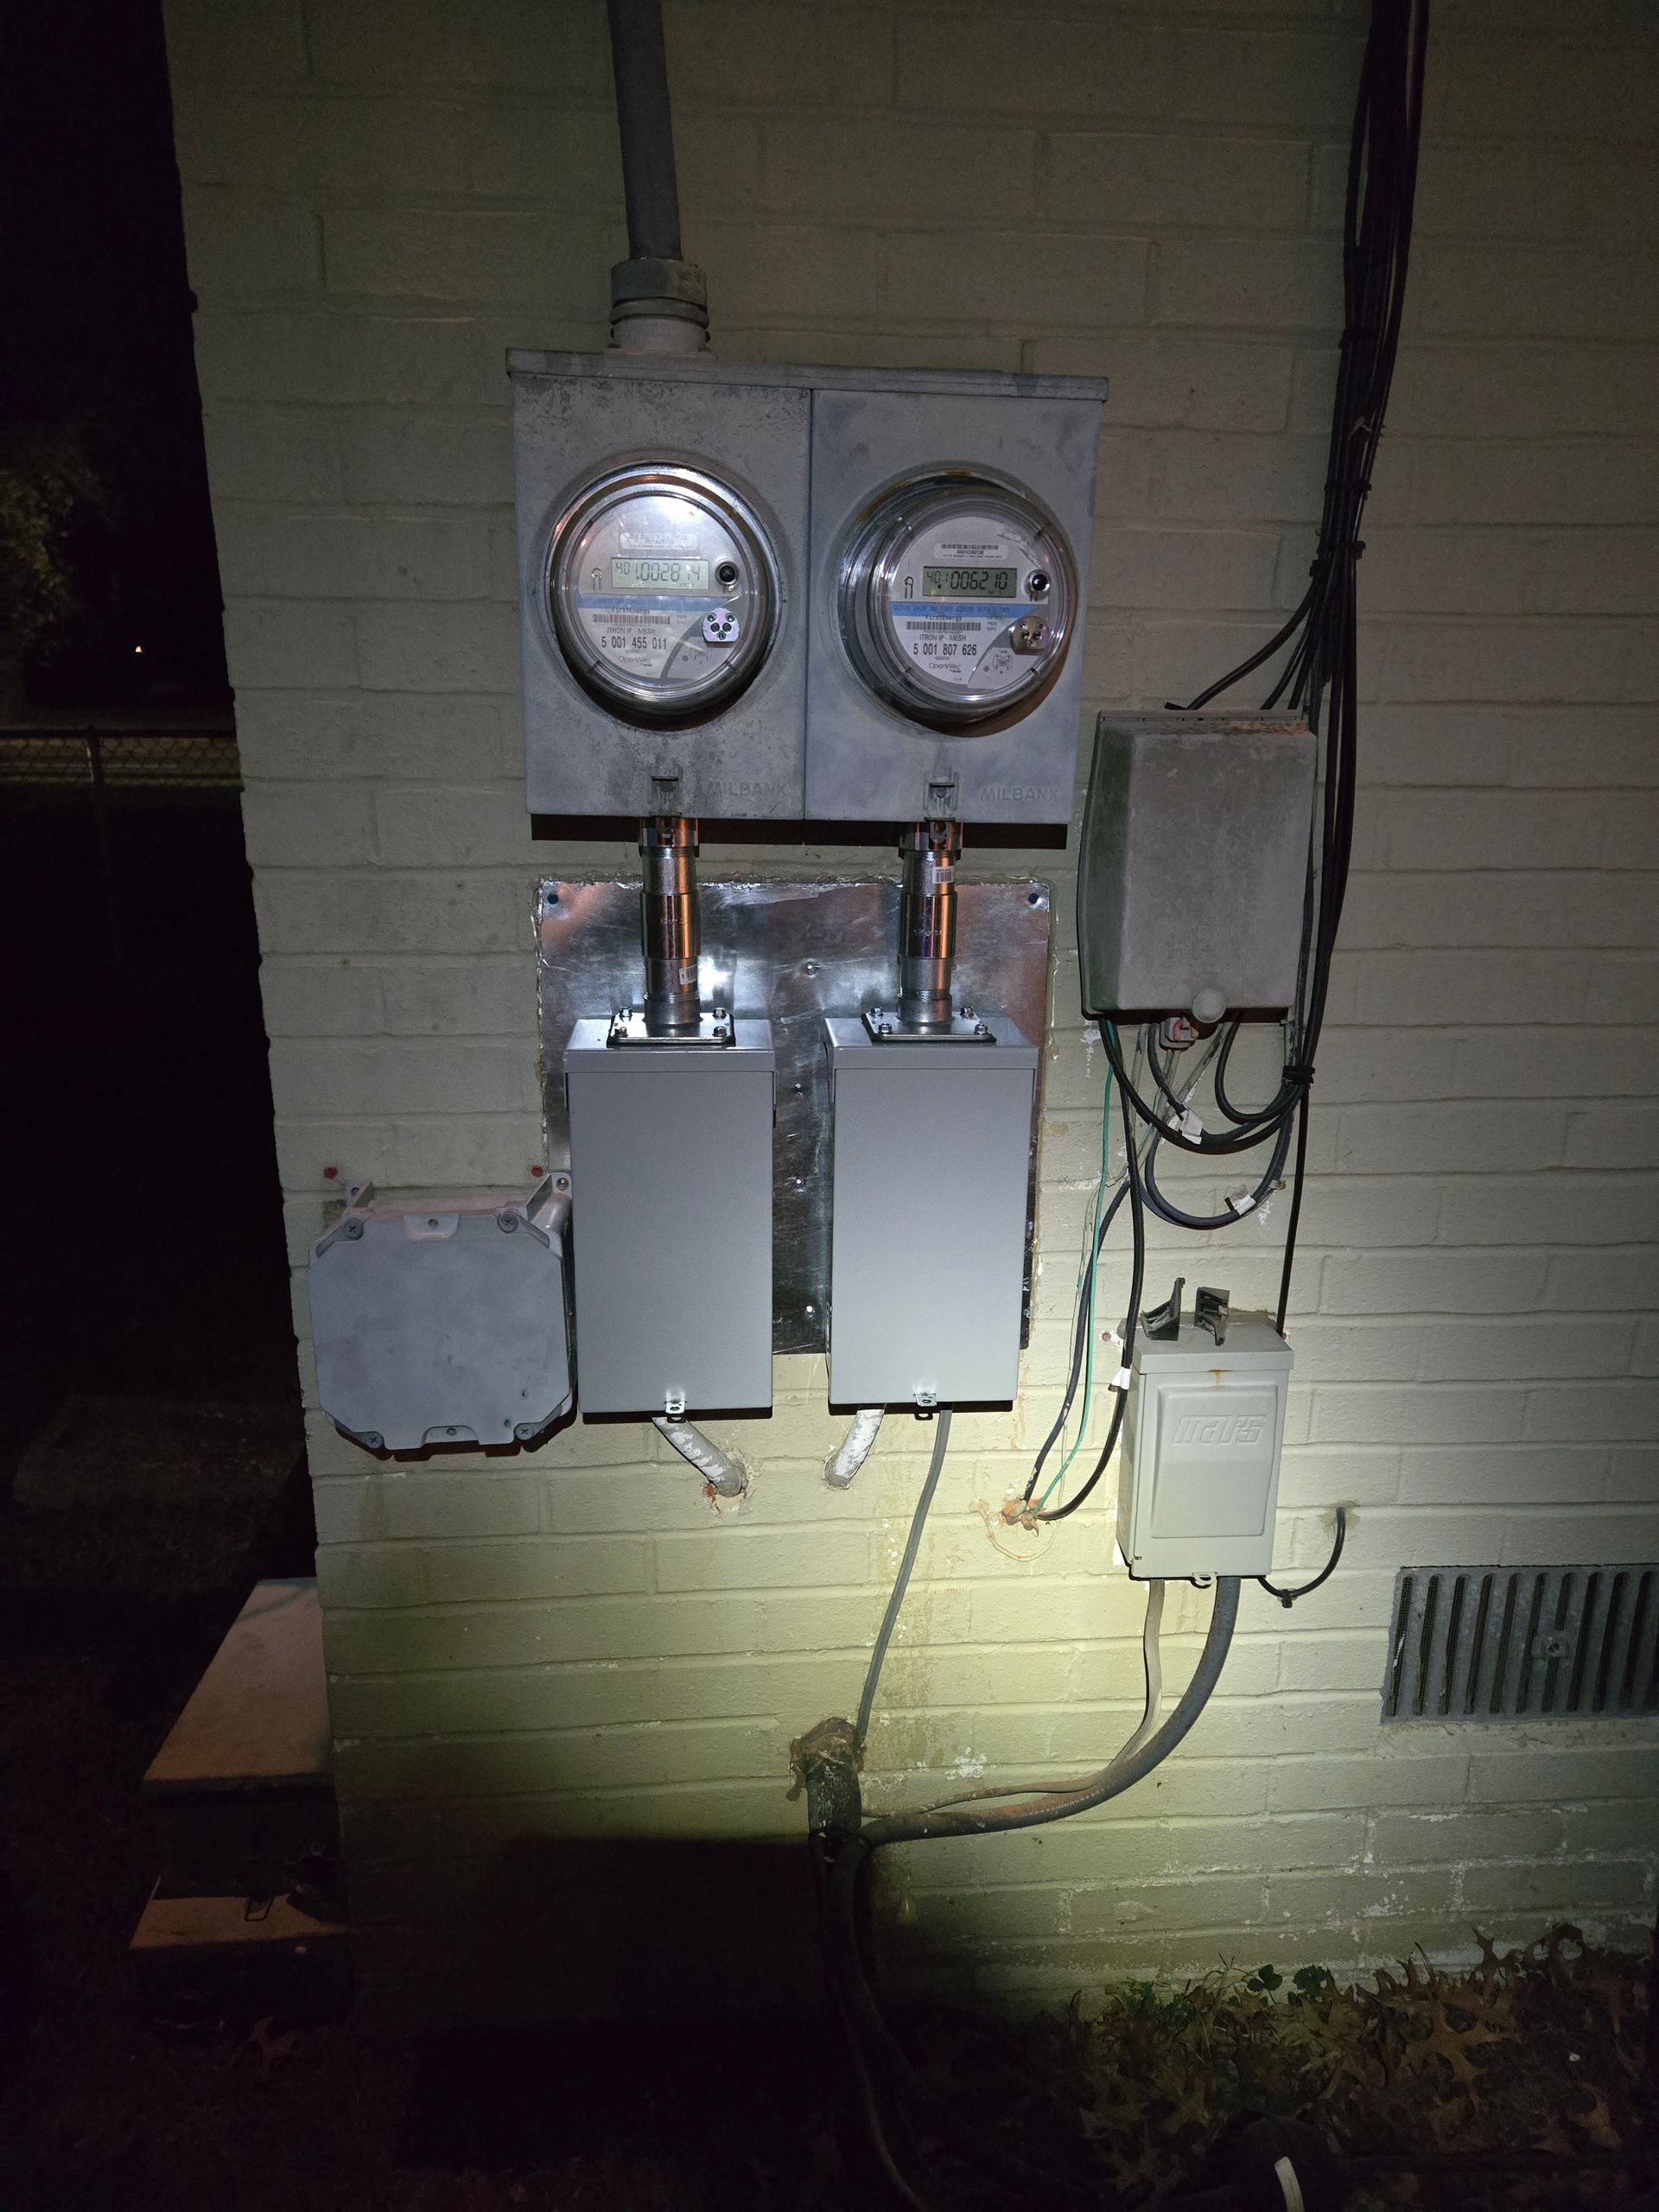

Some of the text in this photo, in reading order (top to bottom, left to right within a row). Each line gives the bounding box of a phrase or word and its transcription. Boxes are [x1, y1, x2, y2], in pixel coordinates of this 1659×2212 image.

[950, 570, 1009, 589] 006210
[601, 636, 667, 650] 5 001 455 011
[913, 643, 977, 657] 5 001 807 626
[980, 787, 1059, 802] MILBANK
